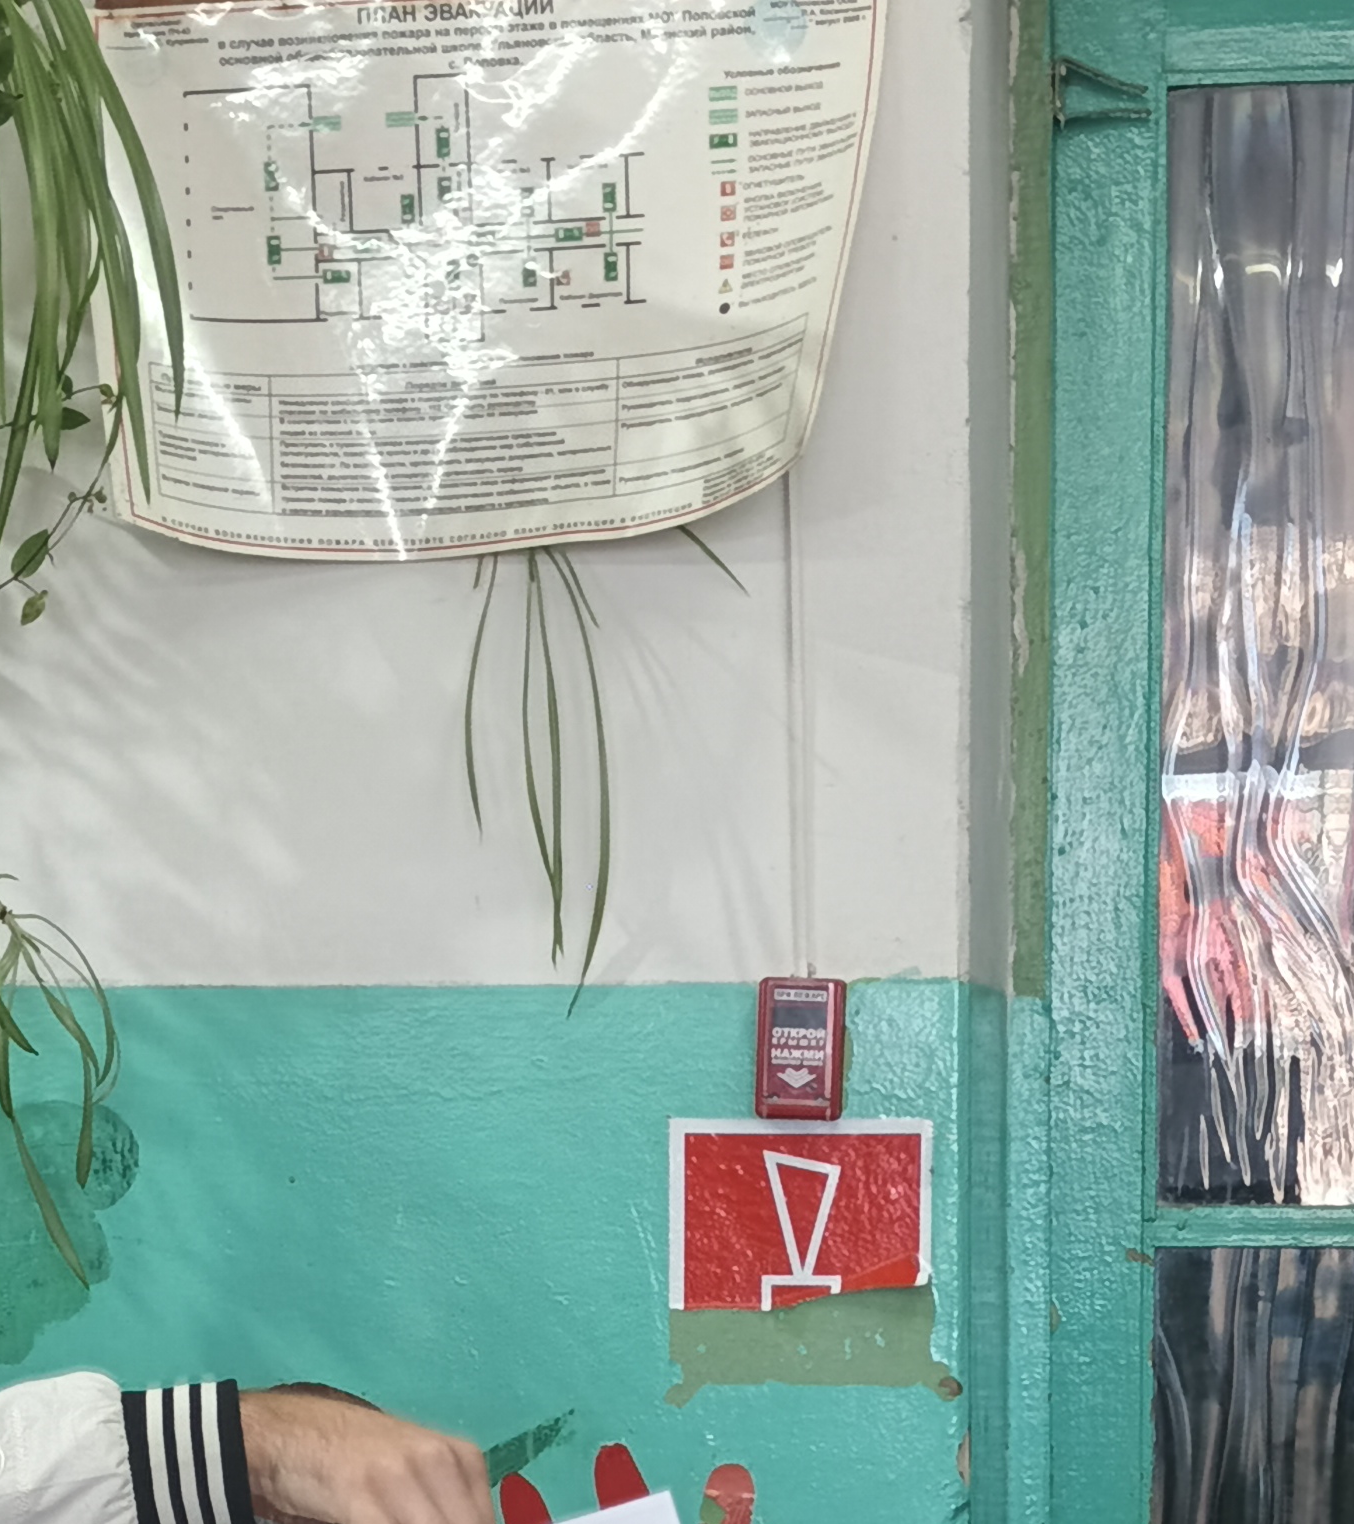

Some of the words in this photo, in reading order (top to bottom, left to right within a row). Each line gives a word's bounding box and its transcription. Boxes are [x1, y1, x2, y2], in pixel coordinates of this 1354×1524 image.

[357, 3, 416, 25] ПЛАН
[771, 1026, 826, 1039] ОТКРОЙ
[771, 1047, 825, 1060] НАЖМИ
